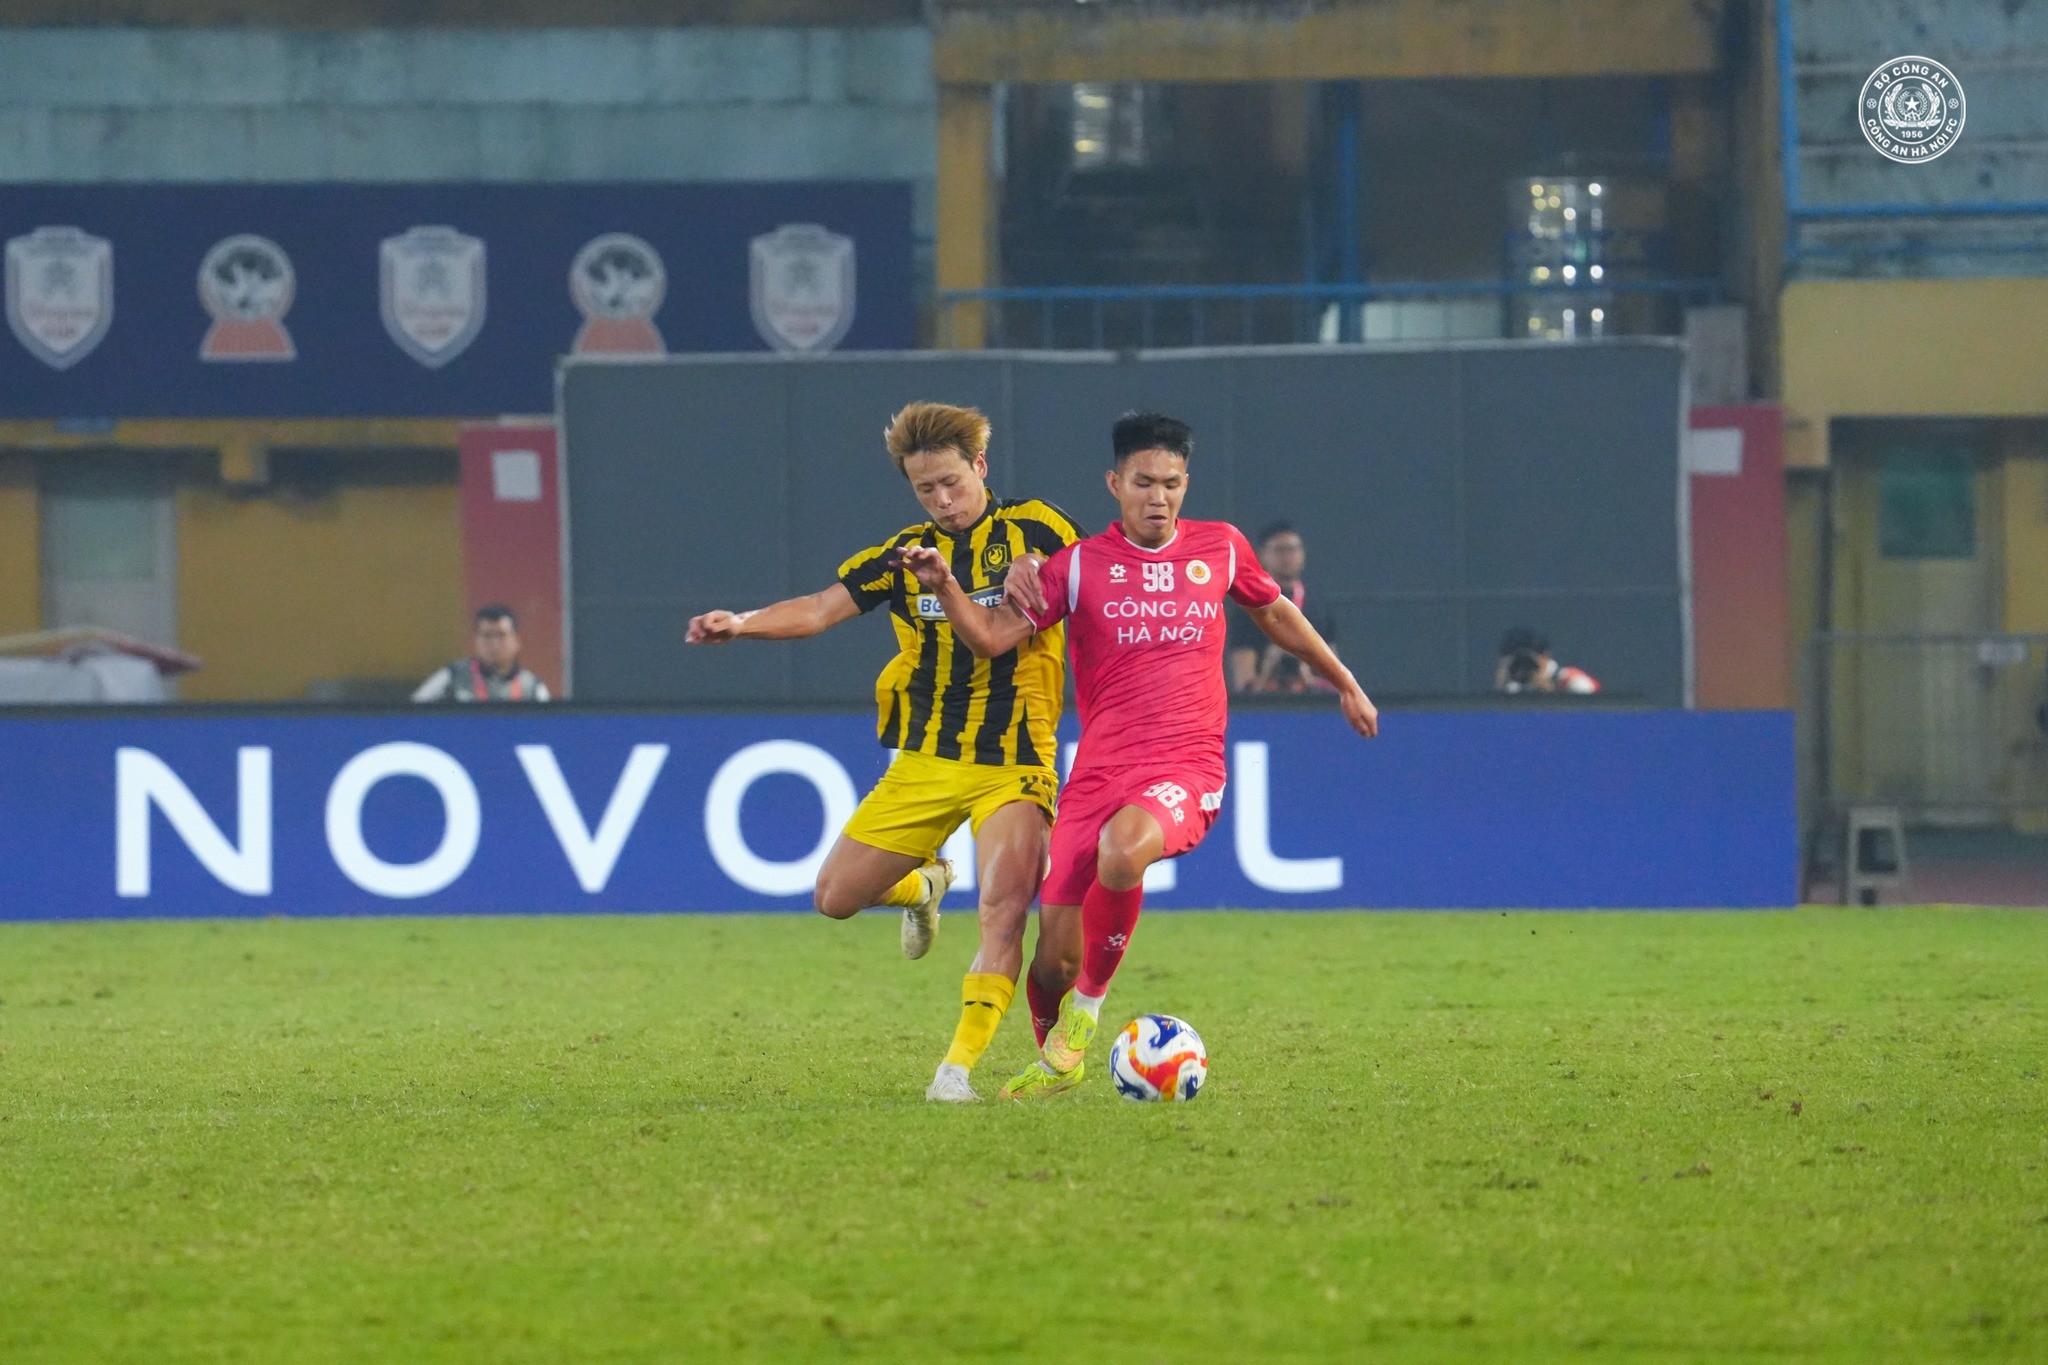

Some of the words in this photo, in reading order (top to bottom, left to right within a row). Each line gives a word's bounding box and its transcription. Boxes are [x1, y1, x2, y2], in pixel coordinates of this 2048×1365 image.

[1142, 562, 1174, 592] 98
[1103, 596, 1177, 619] CÔNG
[1184, 601, 1218, 619] AN
[1117, 622, 1152, 645] HÀ
[1160, 621, 1204, 645] NỘI
[1142, 781, 1187, 808] 98
[116, 739, 1343, 898] NOVOL
